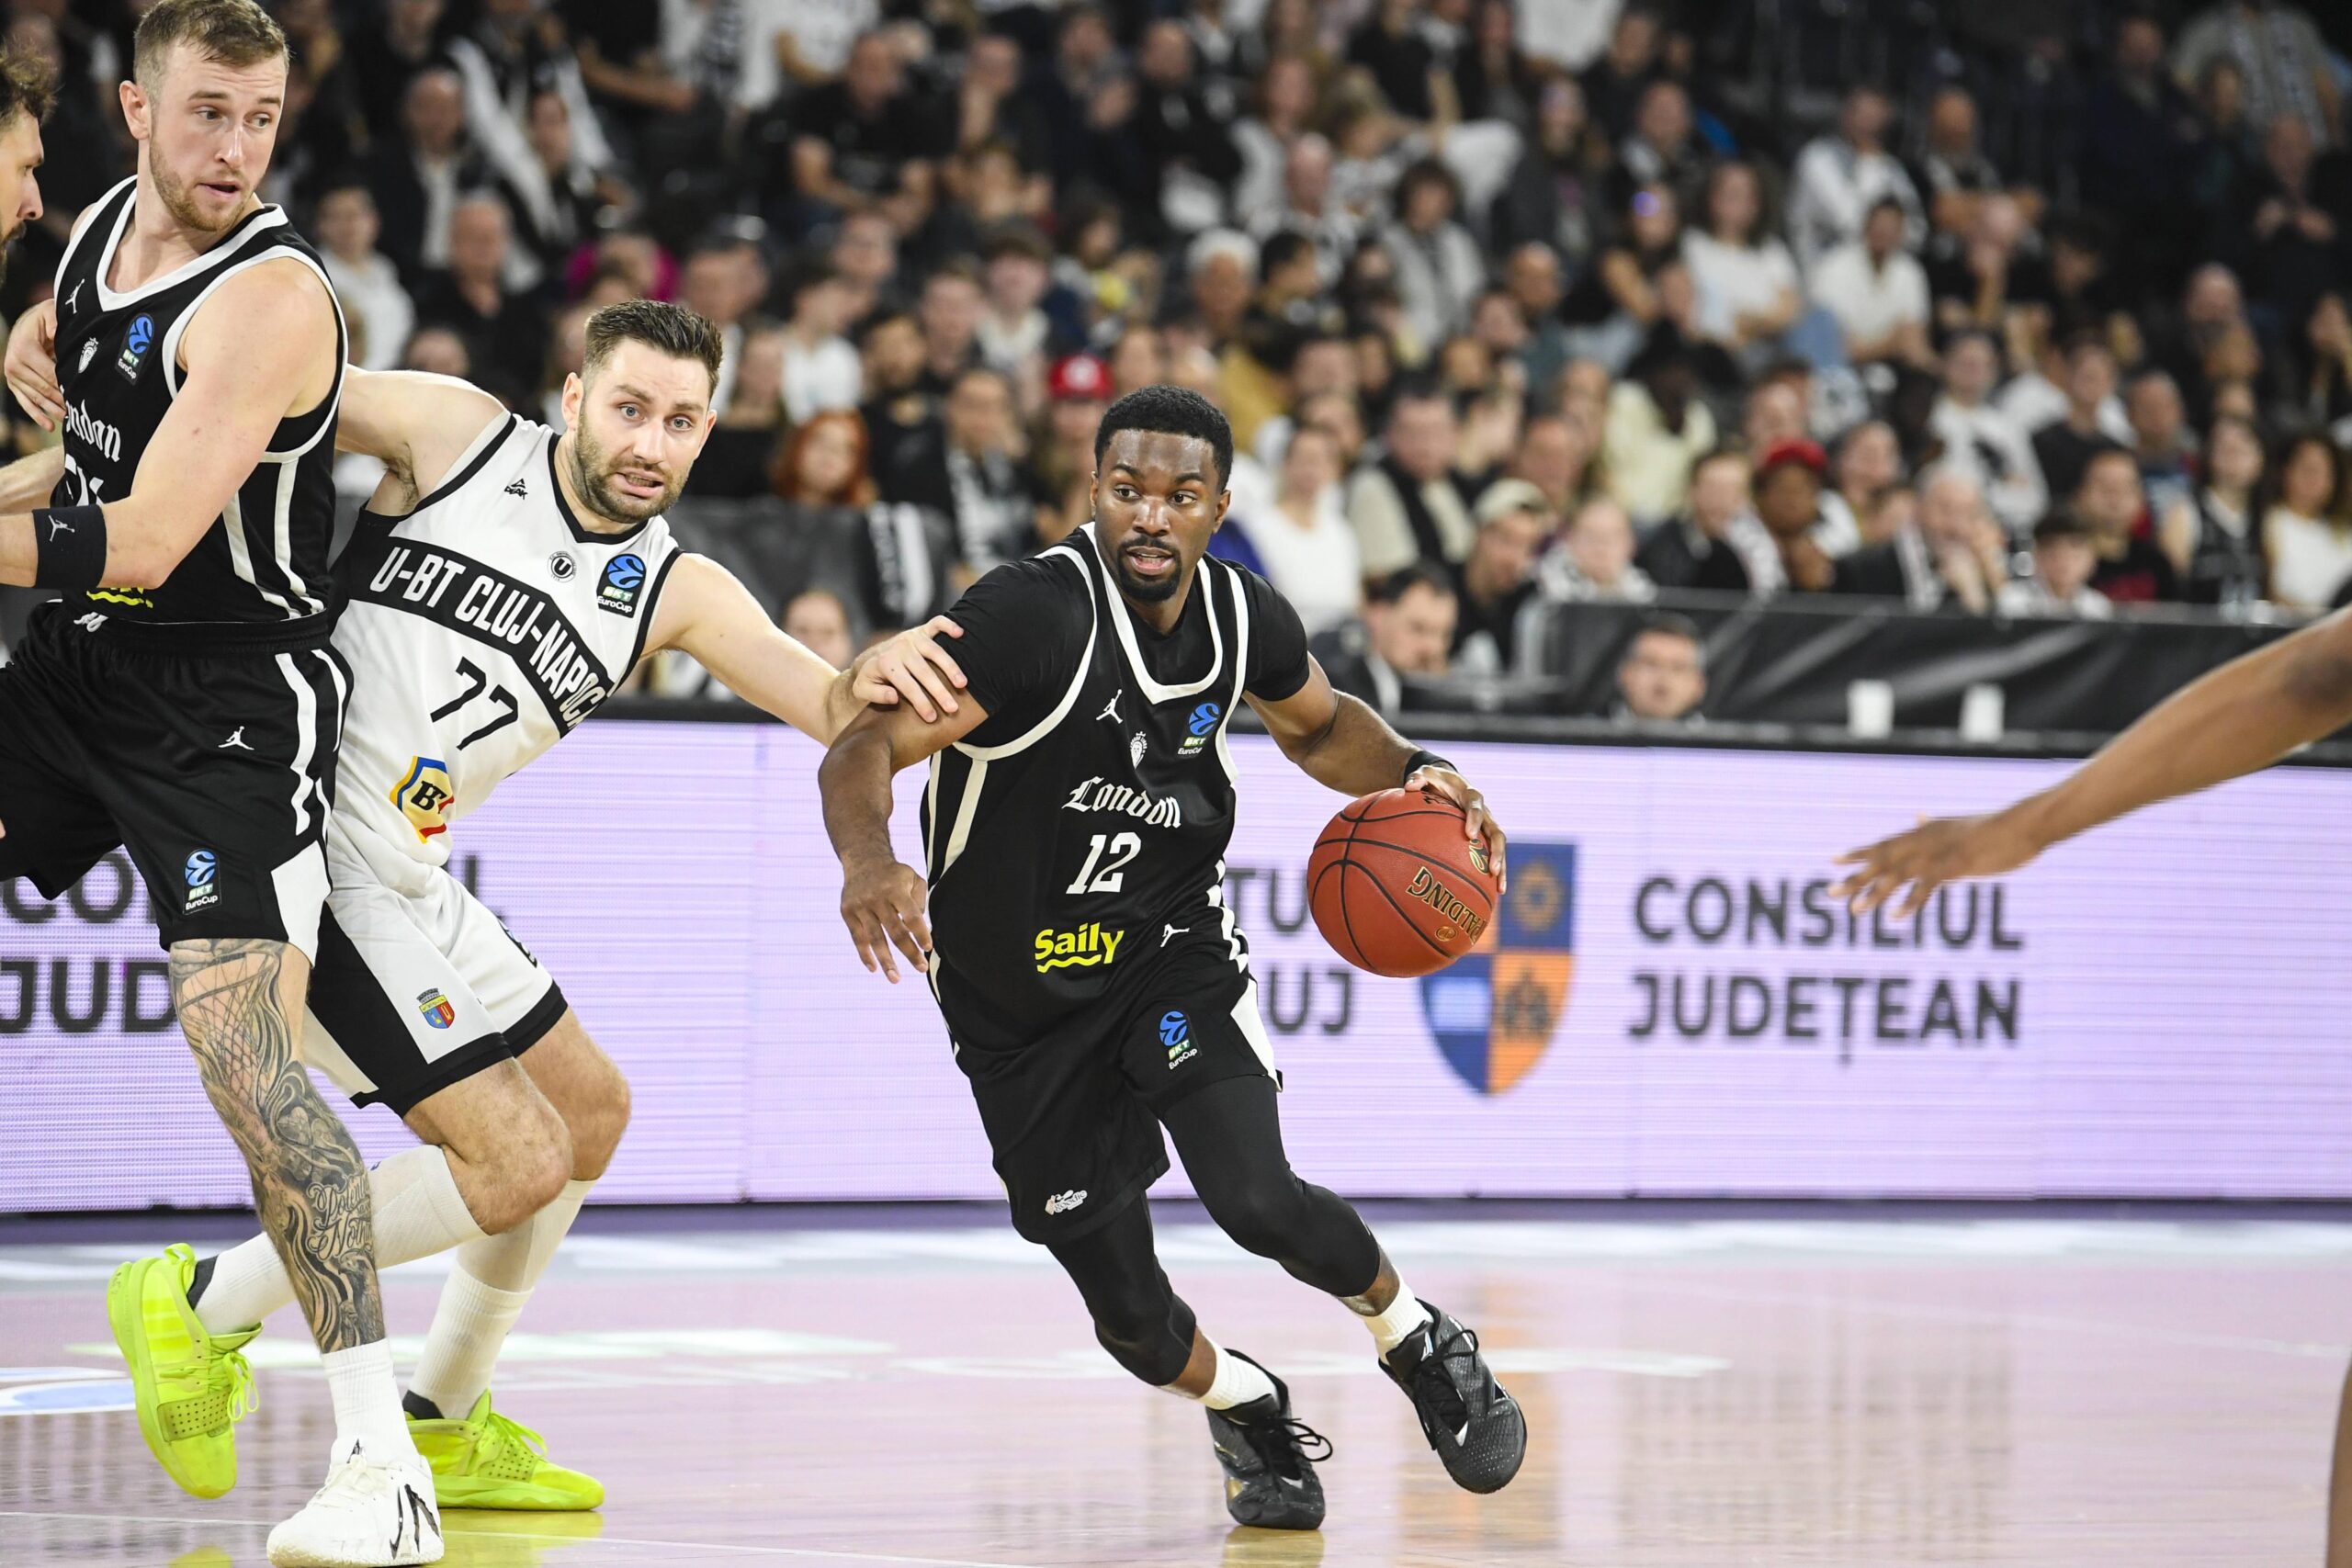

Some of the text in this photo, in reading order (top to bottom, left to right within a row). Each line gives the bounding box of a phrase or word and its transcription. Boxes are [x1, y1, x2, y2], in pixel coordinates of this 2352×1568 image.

[369, 547, 467, 608] U-BT
[597, 595, 633, 614] EuroCup
[430, 656, 518, 750] 77
[1061, 775, 1182, 829] London
[1066, 831, 1142, 895] 12
[186, 895, 219, 910] EuroCup
[1406, 866, 1488, 944] PALDING
[1035, 921, 1125, 964] Saily
[1270, 969, 1352, 1034] UJ
[1169, 1048, 1198, 1070] EuroCup
